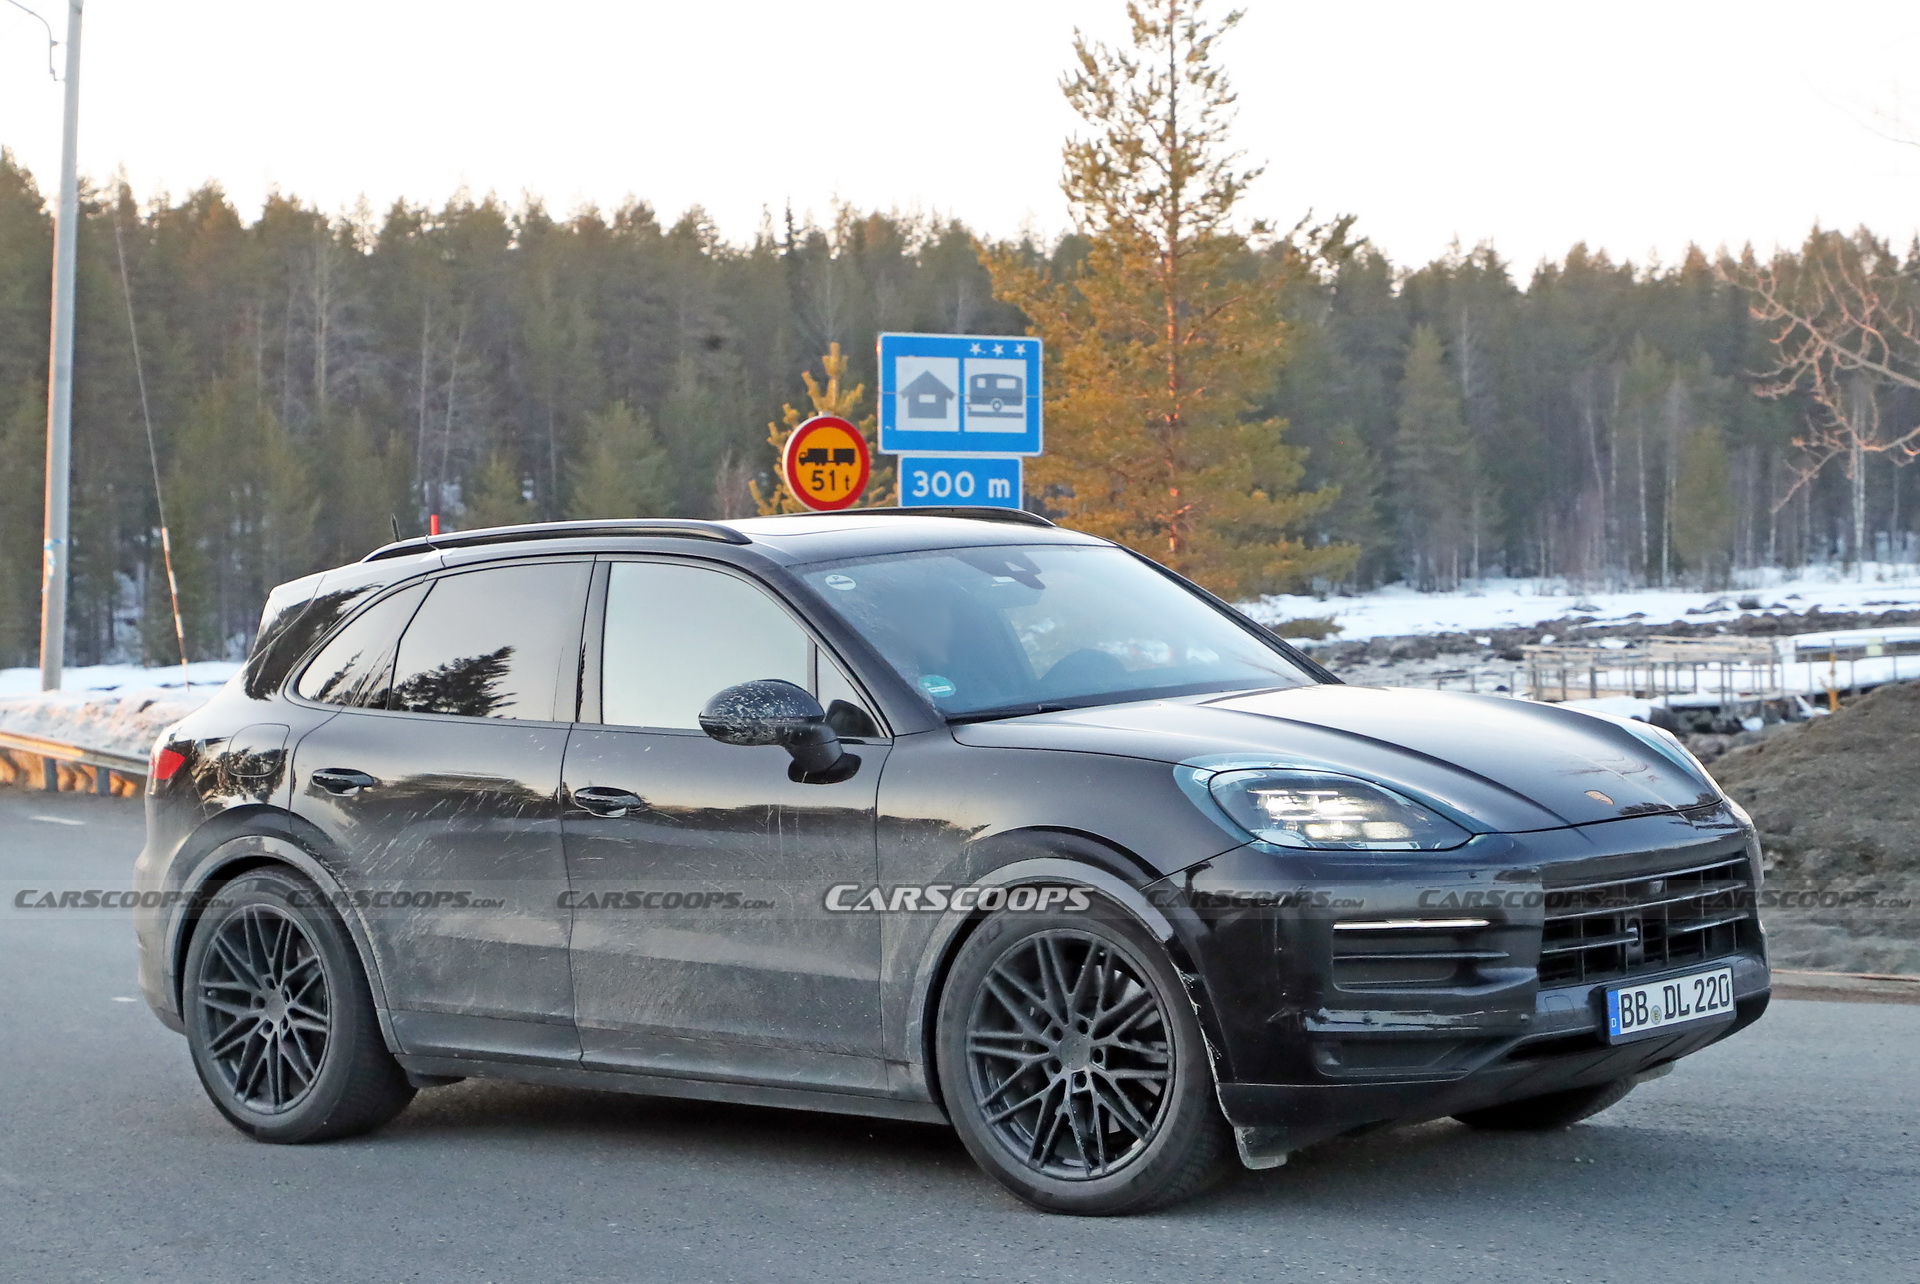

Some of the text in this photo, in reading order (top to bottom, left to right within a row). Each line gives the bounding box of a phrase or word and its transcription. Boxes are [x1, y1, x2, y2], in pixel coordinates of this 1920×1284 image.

[811, 470, 850, 491] 51 t
[912, 470, 1010, 498] 300 m
[1620, 973, 1730, 1028] BB DL 220
